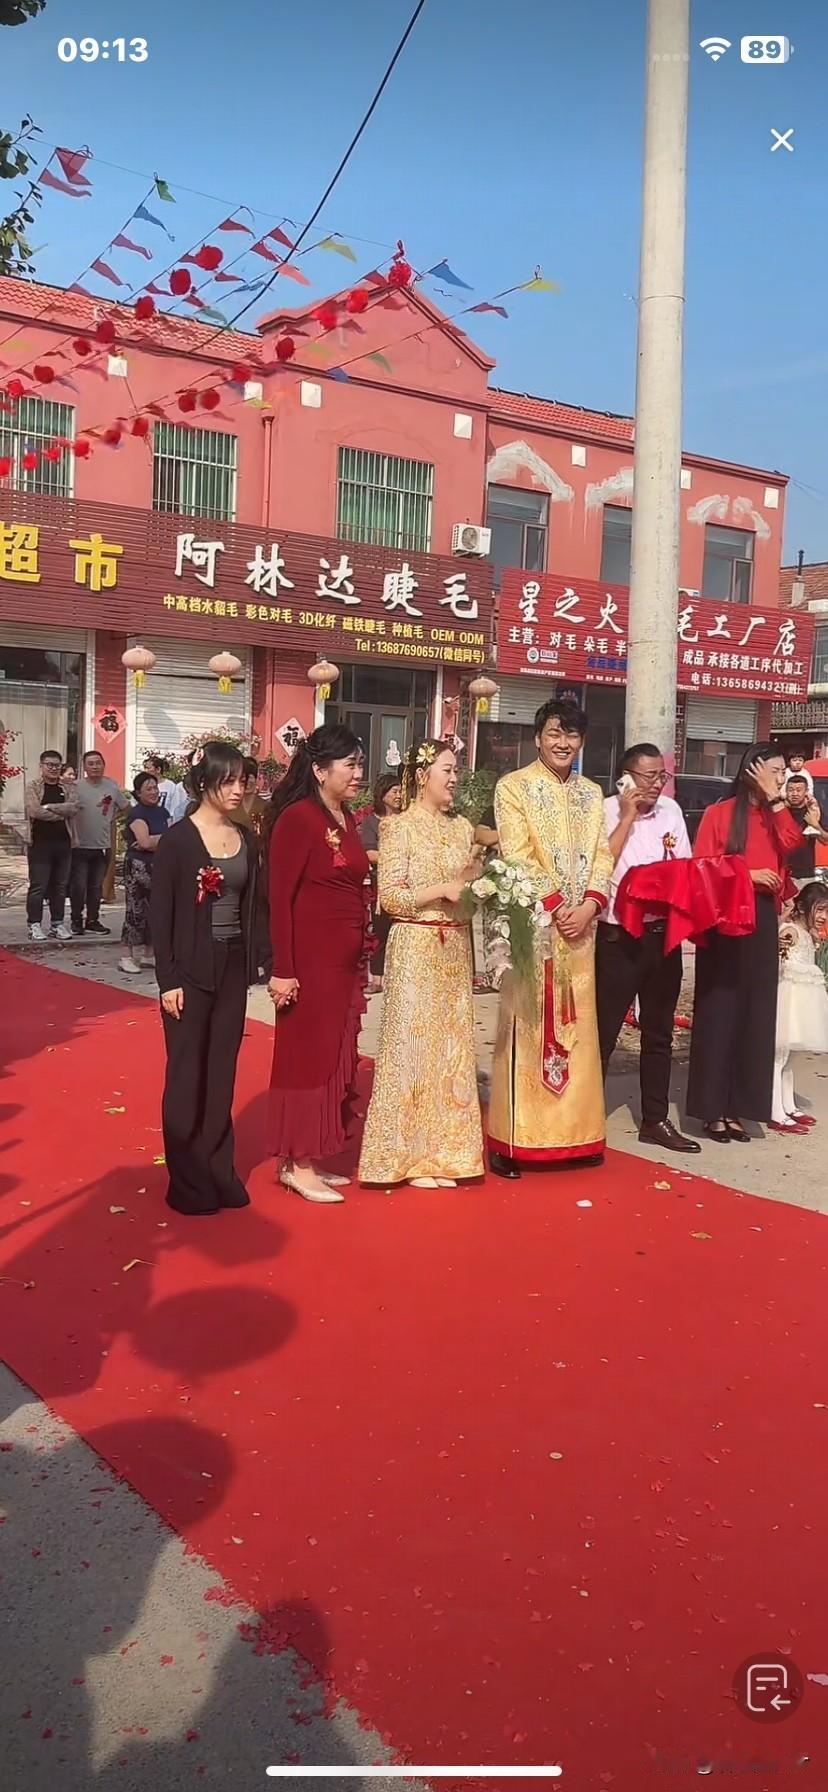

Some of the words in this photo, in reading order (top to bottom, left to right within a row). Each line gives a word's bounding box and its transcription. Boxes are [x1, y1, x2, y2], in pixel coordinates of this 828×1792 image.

[0, 521, 123, 591] 超市
[174, 533, 479, 619] 阿林达睫毛
[245, 604, 292, 623] 彩色对毛
[299, 612, 336, 629] 3D化纤
[342, 616, 386, 635] 磁铁睫毛
[392, 622, 424, 639] 种植毛
[430, 628, 455, 642] OEM
[459, 631, 484, 645] ODM
[518, 580, 797, 657] 星之火毛工厂店
[549, 631, 577, 651] 对毛
[682, 649, 705, 666] 成品
[707, 651, 804, 676] 承接各道工序代加工
[98, 709, 119, 732] 福
[282, 725, 299, 747] 福
